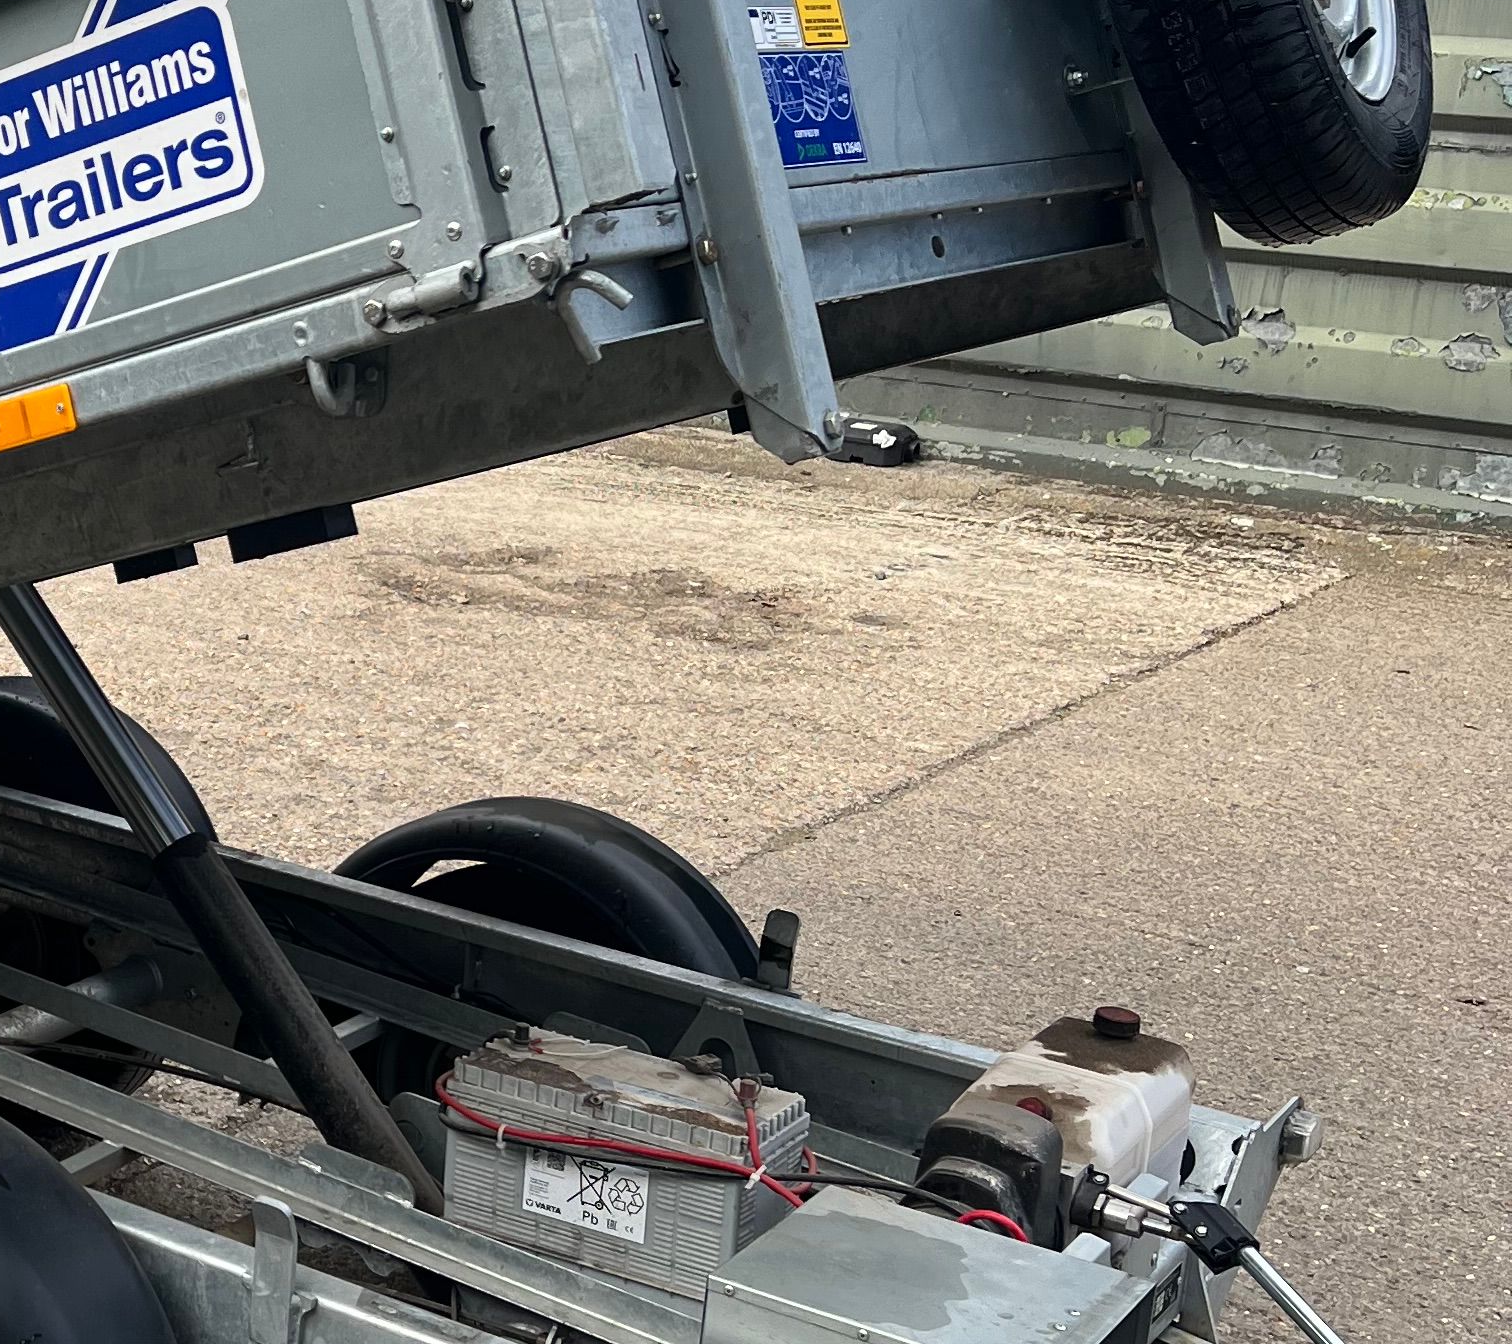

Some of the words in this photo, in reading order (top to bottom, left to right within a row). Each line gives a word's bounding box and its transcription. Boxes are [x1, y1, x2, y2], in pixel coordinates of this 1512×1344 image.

[32, 41, 216, 139] Williams
[535, 1201, 561, 1214] VARTA
[582, 1210, 599, 1226] Pb
